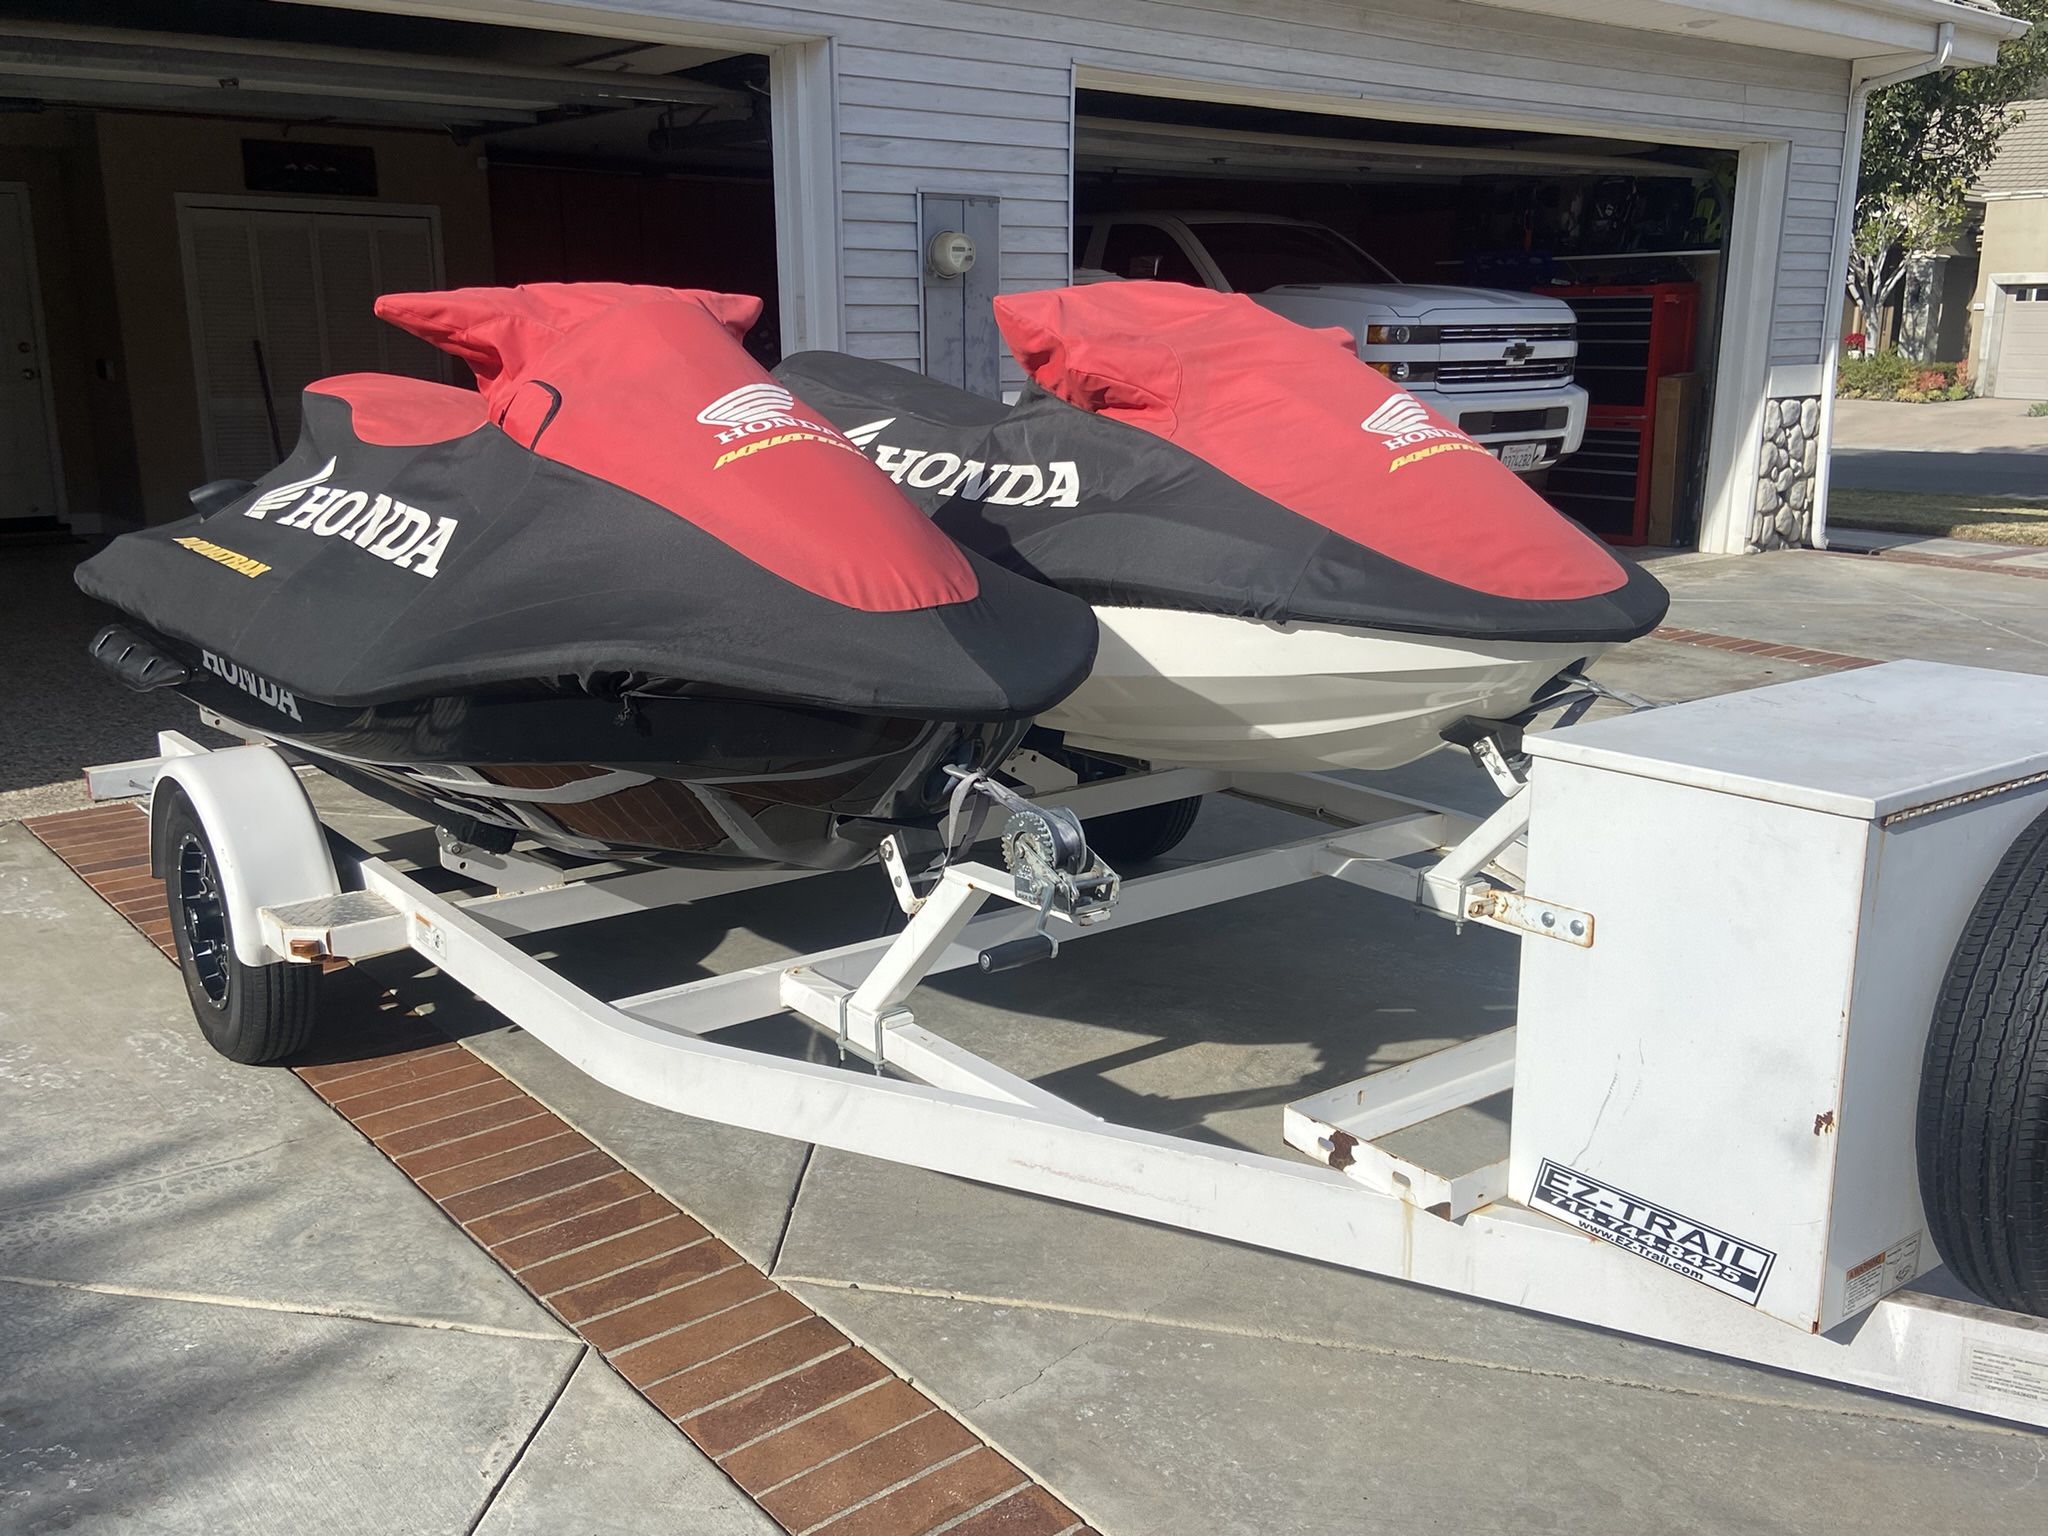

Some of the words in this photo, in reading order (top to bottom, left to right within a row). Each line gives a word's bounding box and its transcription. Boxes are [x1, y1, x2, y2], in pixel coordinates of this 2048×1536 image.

[713, 417, 845, 445] HONDA
[1381, 428, 1474, 451] HONDA
[875, 444, 1080, 508] HONDA
[276, 486, 459, 579] HONDA
[202, 649, 302, 723] HONDA
[1543, 1170, 1758, 1276] EZ-TRAIL
[1550, 1191, 1742, 1283] 714-744-8425
[1578, 1219, 1704, 1281] www.EZ-Trail.com
